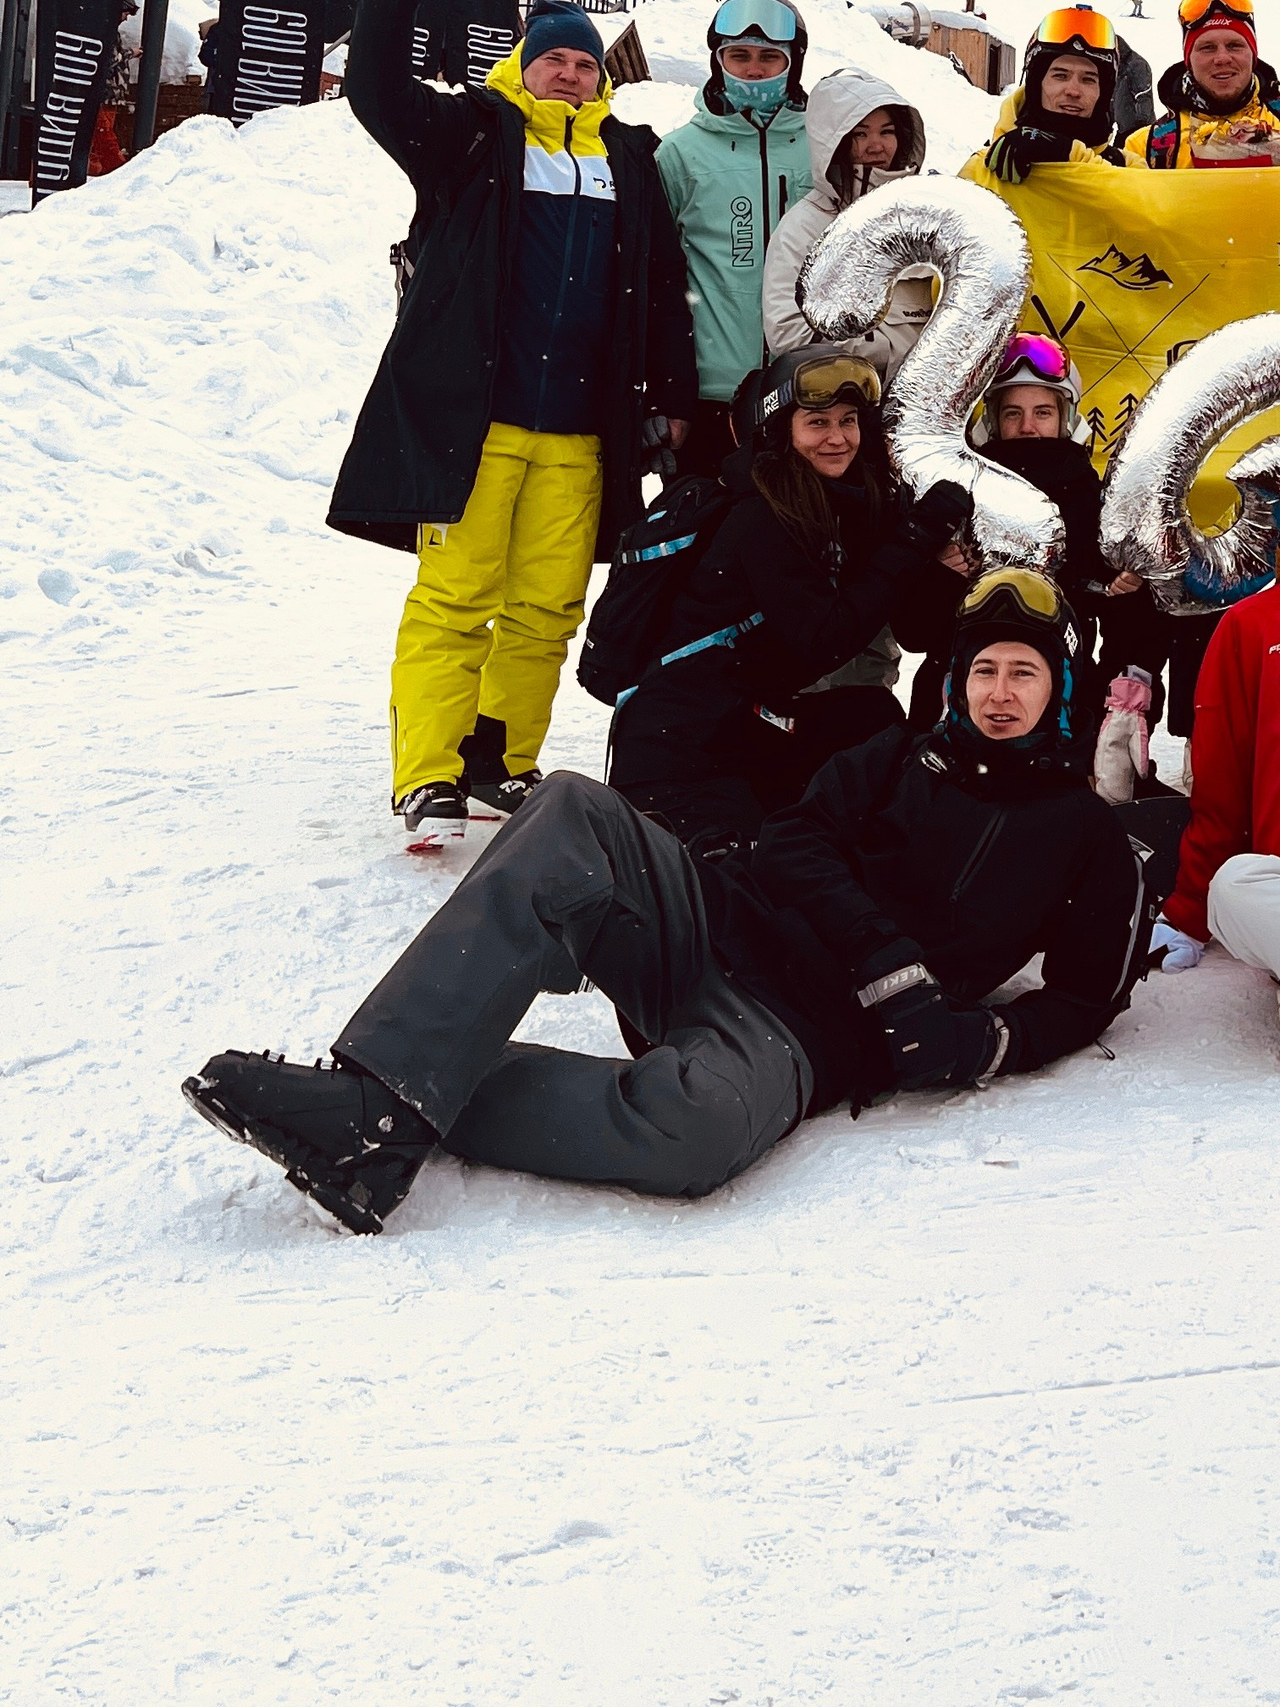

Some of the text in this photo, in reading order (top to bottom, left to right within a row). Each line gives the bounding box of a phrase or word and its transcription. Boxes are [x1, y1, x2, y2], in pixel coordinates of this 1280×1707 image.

[241, 5, 307, 56] 109
[37, 30, 103, 195] УДИЯ 109
[731, 196, 754, 267] NITRO
[883, 968, 918, 990] LEKI
